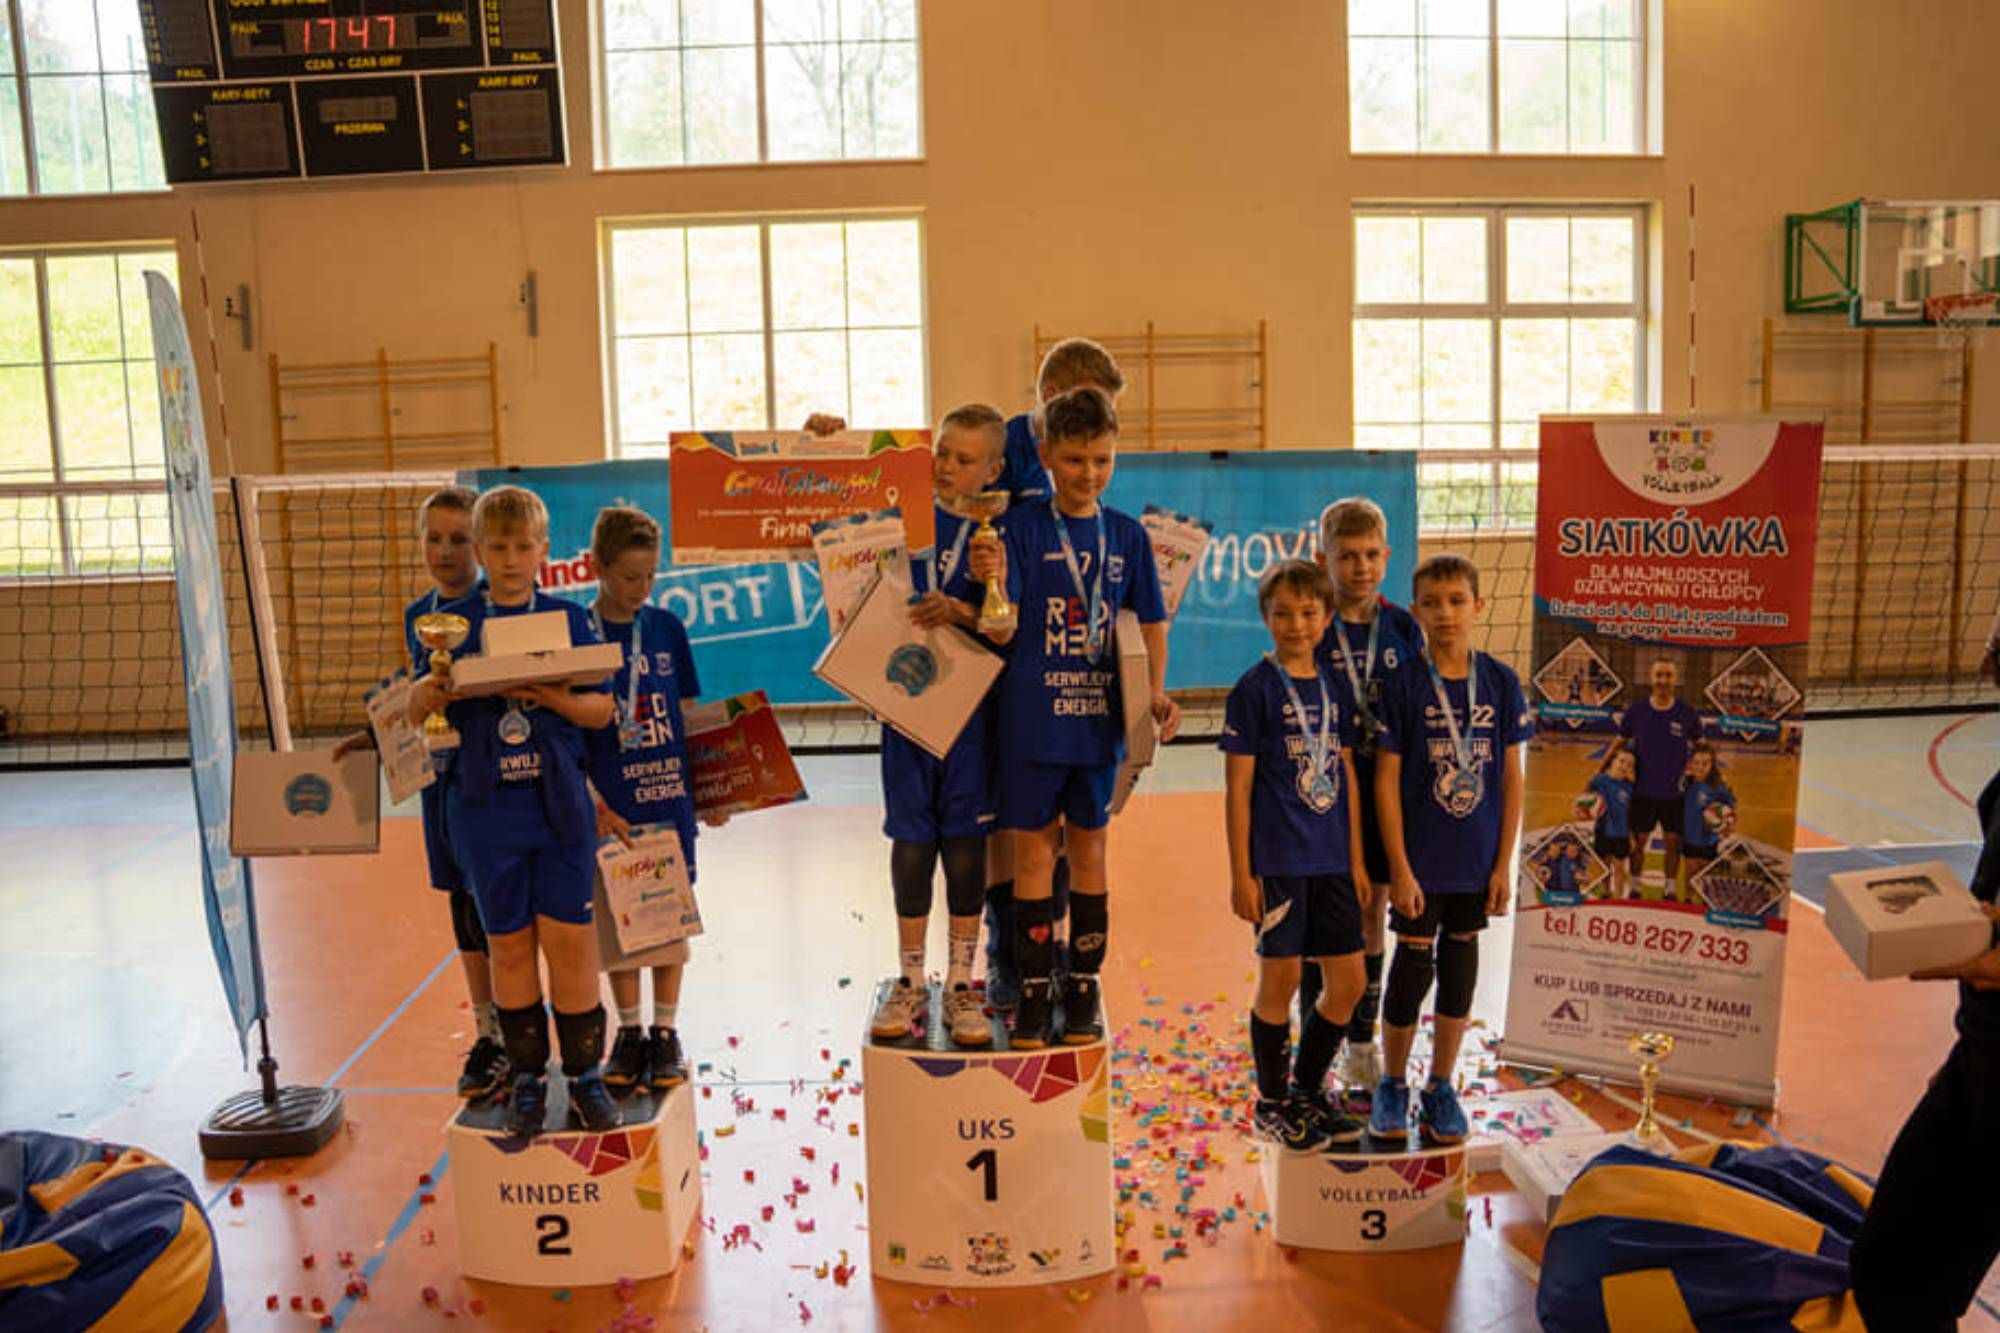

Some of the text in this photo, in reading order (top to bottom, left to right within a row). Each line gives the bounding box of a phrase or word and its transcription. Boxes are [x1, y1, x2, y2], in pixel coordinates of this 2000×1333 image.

[1197, 519, 1319, 581] movi
[1560, 509, 1788, 556] SIATKÓWKA
[1574, 579, 1680, 598] DZIEWCZYNKI
[1590, 564, 1620, 579] DLA
[657, 575, 770, 628] ORT
[1384, 648, 1398, 669] 6
[1544, 911, 1581, 937] tel.
[1588, 916, 1638, 945] 608
[1644, 925, 1694, 955] 267
[1699, 933, 1749, 966] 333
[1534, 975, 1565, 988] KUP
[1570, 978, 1600, 995] LUB
[1603, 983, 1688, 1008] SPRZEDAJ
[1691, 999, 1702, 1011] Z
[1705, 1001, 1752, 1018] NAMI
[958, 1118, 1015, 1140] UKS
[966, 1149, 998, 1201] 1
[500, 1183, 600, 1204] KINDER
[1320, 1187, 1428, 1201] VOLLEYBALL
[536, 1215, 572, 1255] 2
[1361, 1210, 1386, 1240] 3
